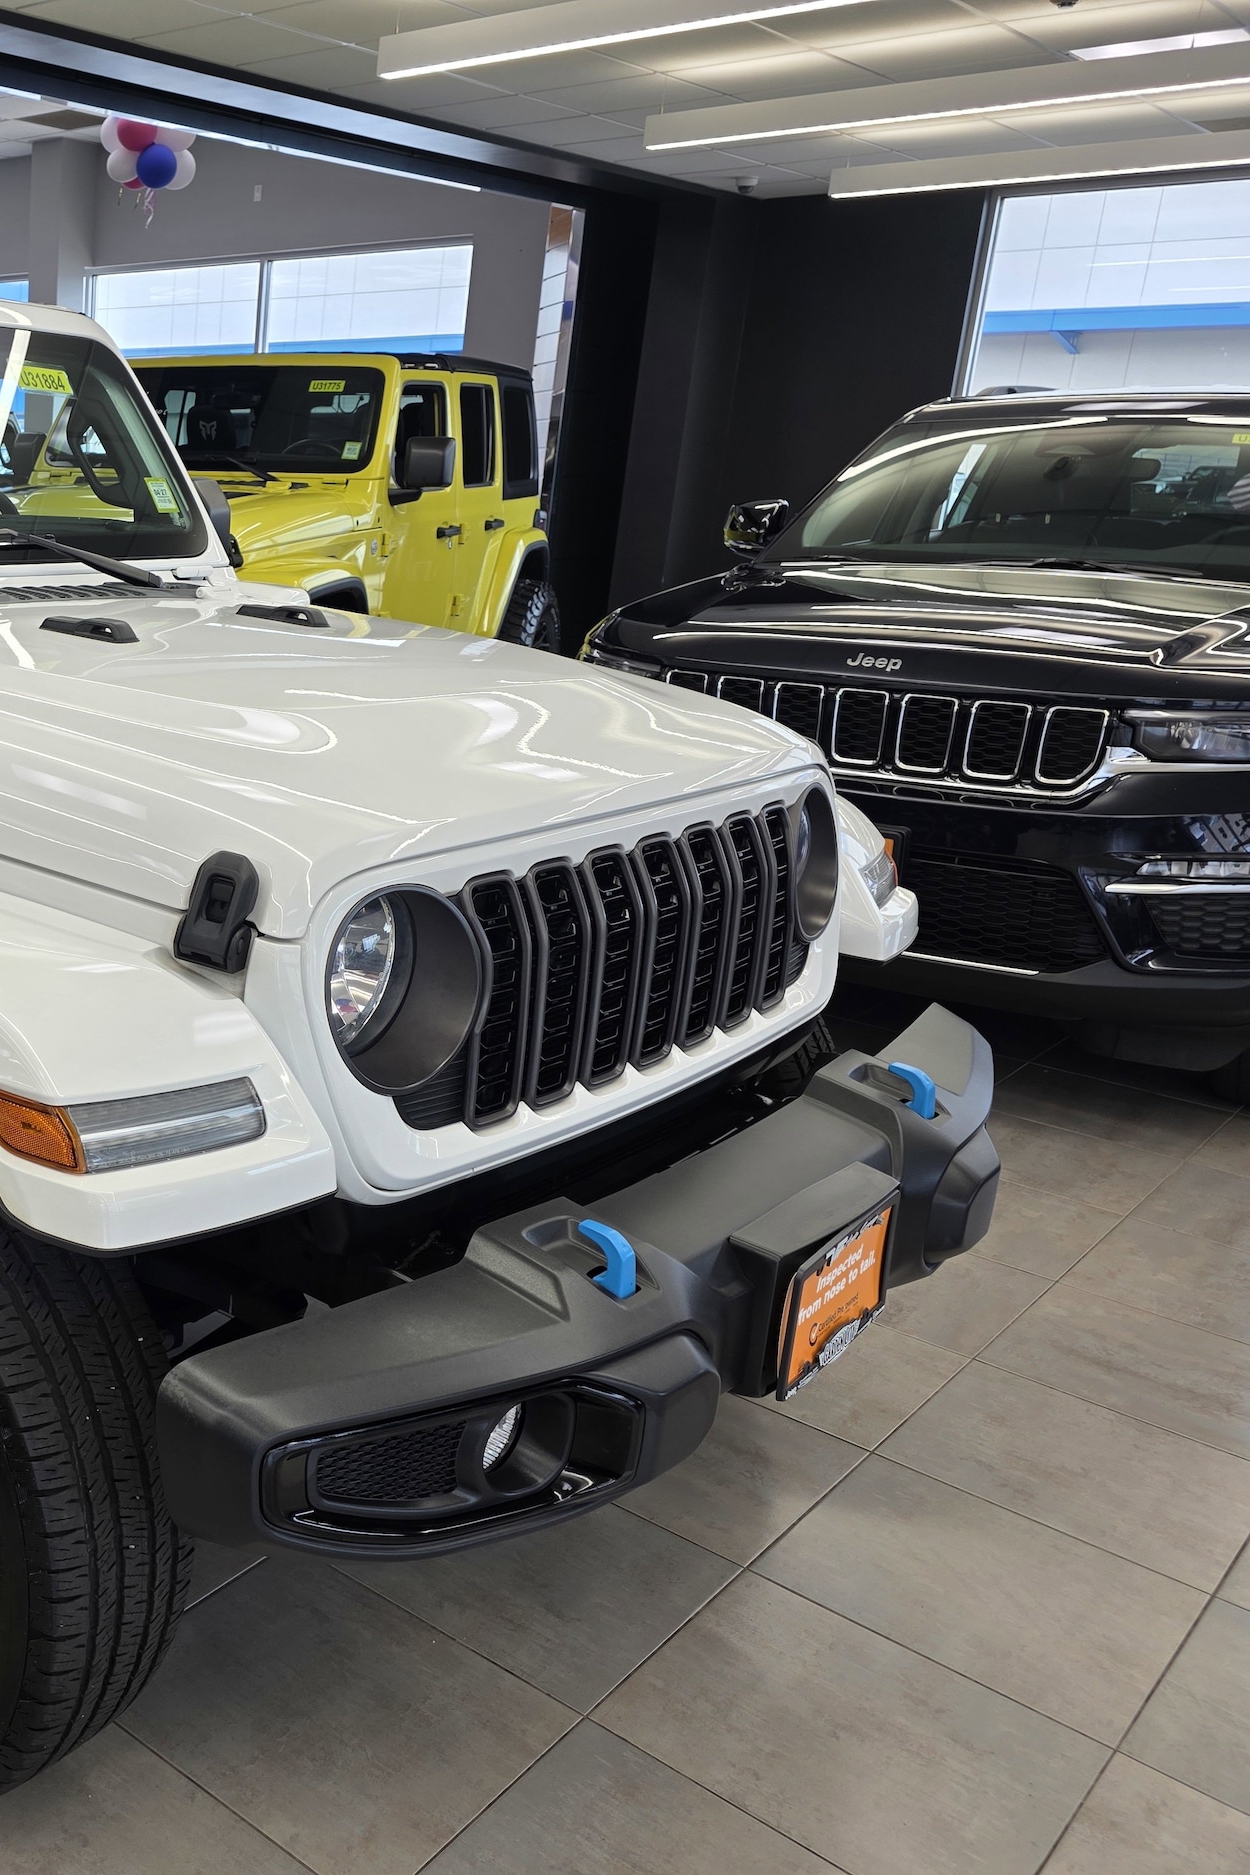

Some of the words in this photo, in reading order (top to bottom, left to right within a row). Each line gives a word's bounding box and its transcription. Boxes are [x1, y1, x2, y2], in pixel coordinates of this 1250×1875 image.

[21, 371, 66, 391] U31884
[312, 382, 341, 390] U31775
[1238, 435, 1250, 443] U
[846, 652, 903, 672] Jeep
[816, 1243, 864, 1294] Inspected
[797, 1300, 822, 1326] from
[823, 1281, 846, 1306] nose
[848, 1270, 858, 1285] to
[859, 1249, 876, 1274] tail.
[818, 1310, 837, 1332] Certified
